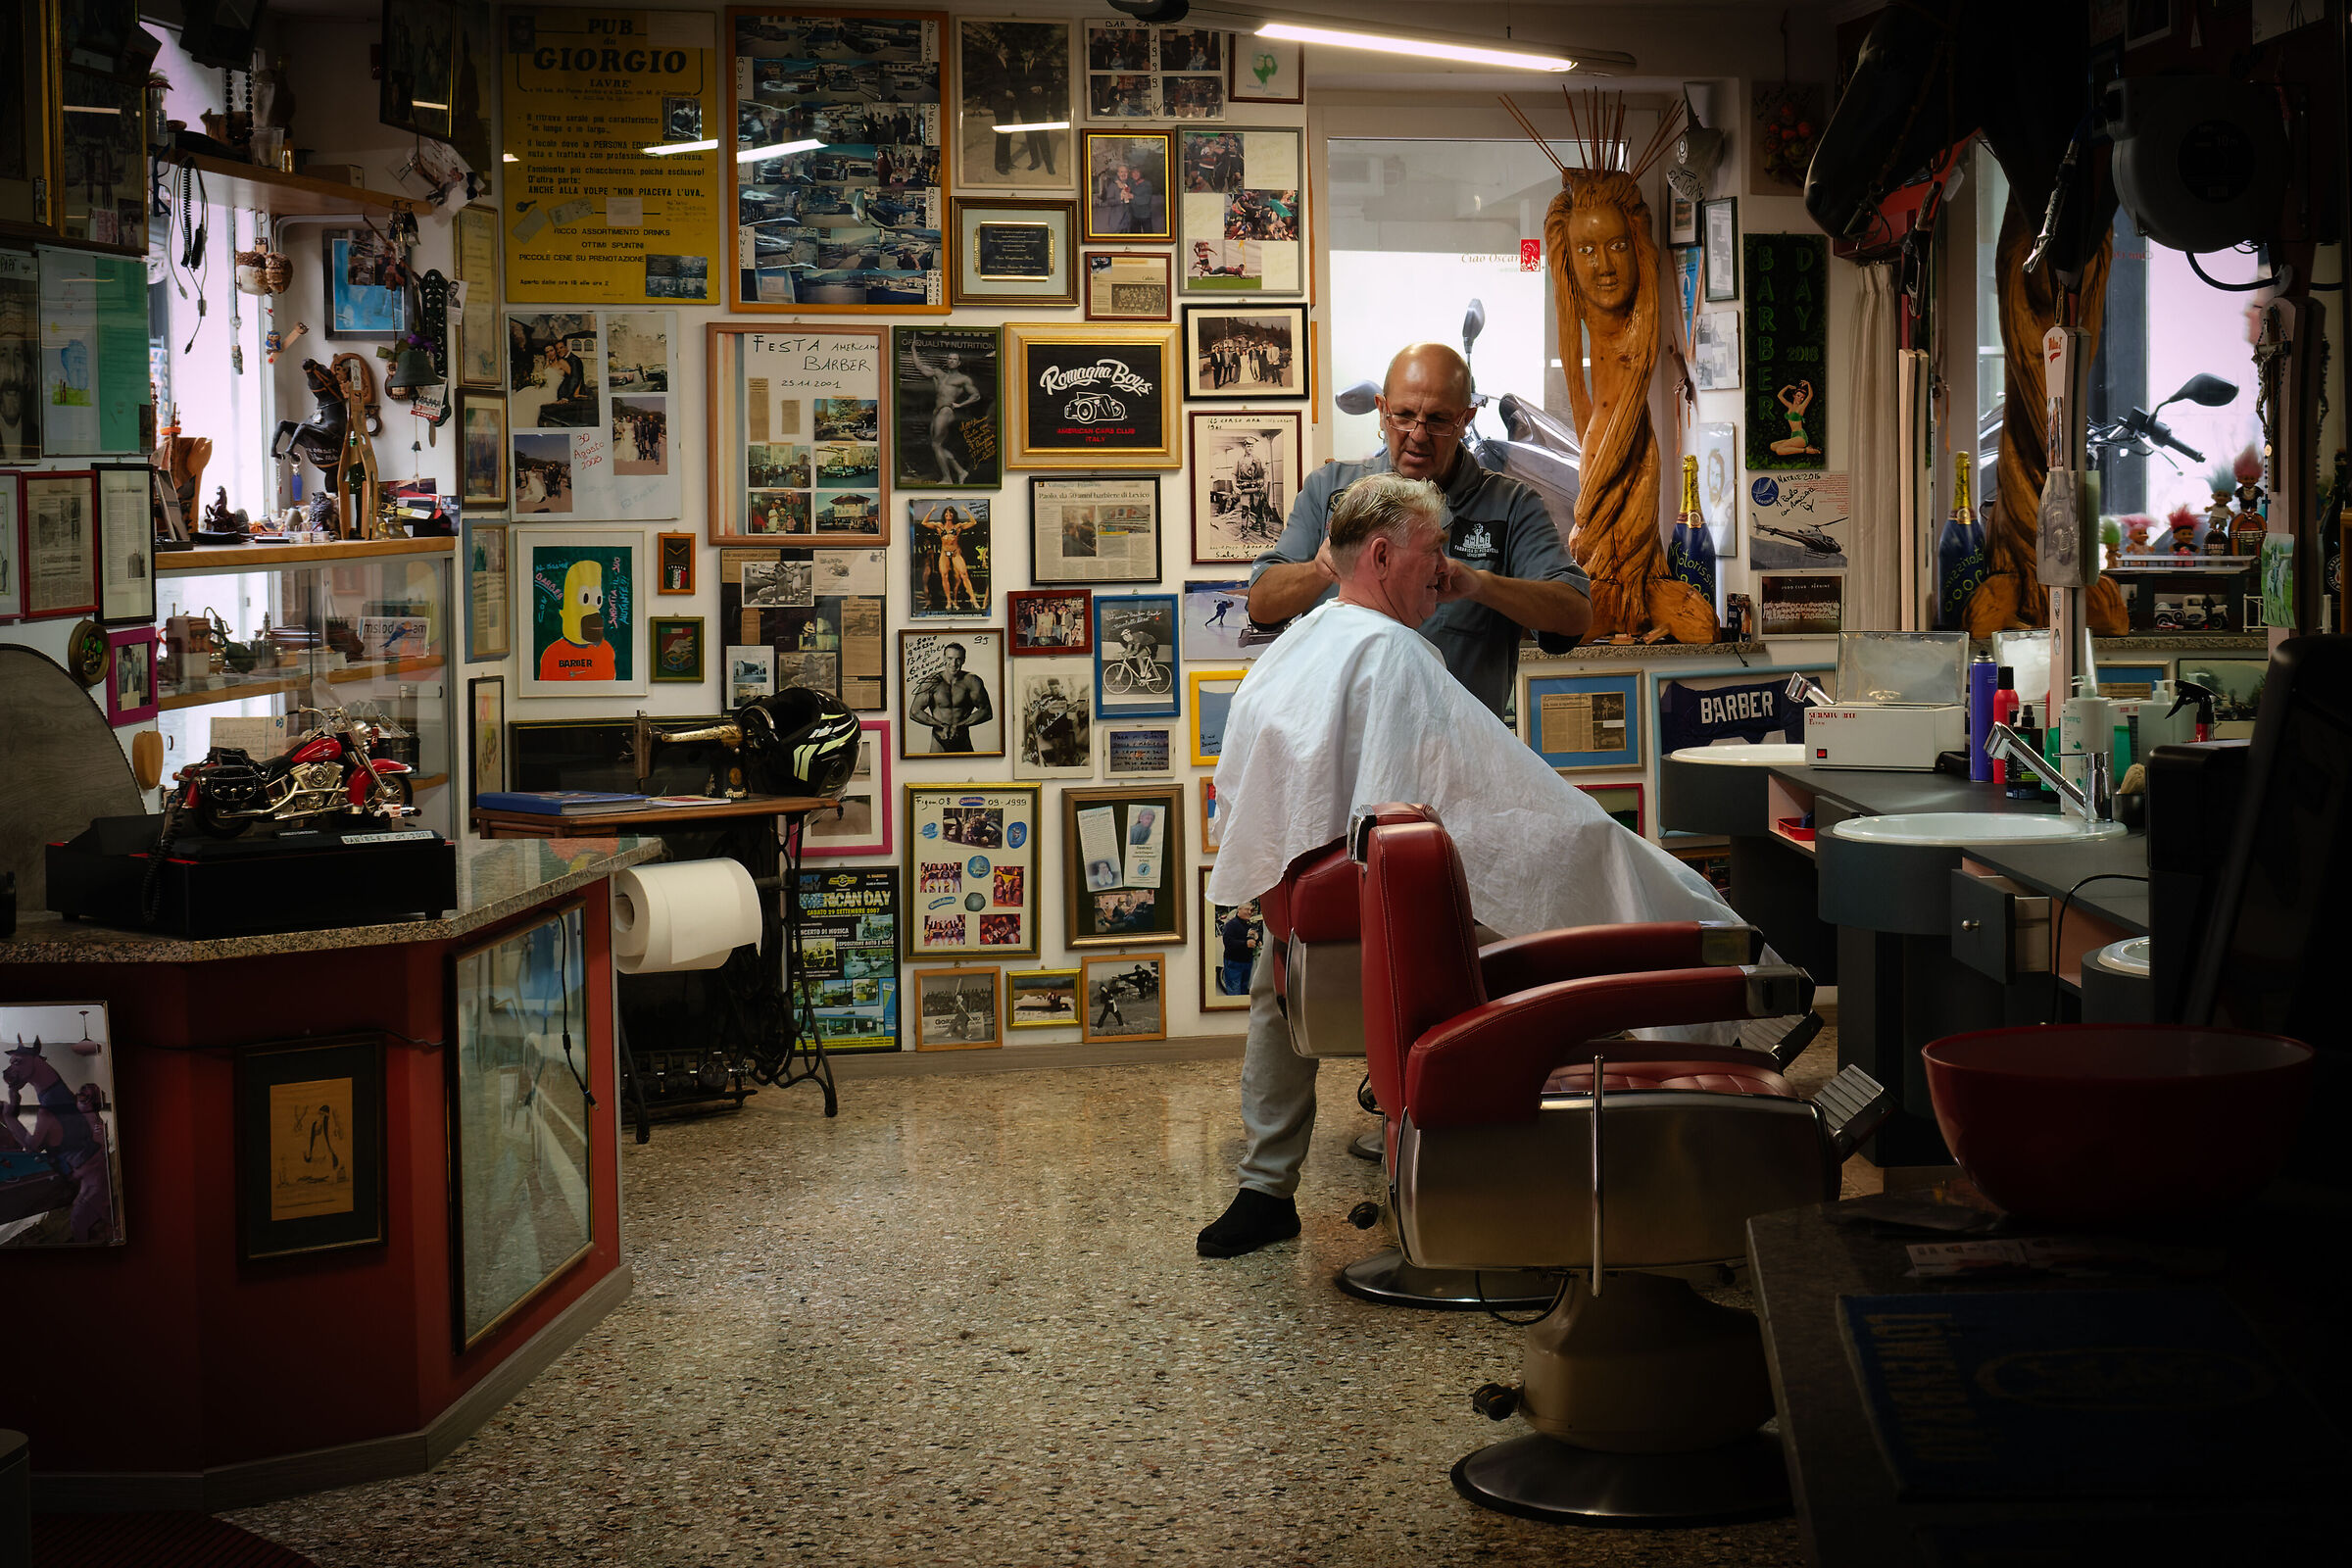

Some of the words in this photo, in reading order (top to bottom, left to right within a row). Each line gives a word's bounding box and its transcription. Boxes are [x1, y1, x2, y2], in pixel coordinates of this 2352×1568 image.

[588, 19, 633, 35] PUB
[534, 47, 687, 74] GIORGIO
[639, 187, 671, 196] PIACEVA
[1461, 254, 1486, 263] Ciao
[1489, 253, 1521, 263] Oscar
[1794, 245, 1815, 332] DAY
[1756, 245, 1778, 421] BARBER
[754, 334, 819, 353] FESTA
[915, 339, 950, 349] QUALITY
[953, 341, 995, 350] NUTRITION
[803, 356, 871, 371] BARBER
[1040, 365, 1113, 396] Romagna
[1096, 359, 1153, 398] Boys
[576, 432, 591, 447] 30
[572, 439, 606, 461] Agosto
[559, 659, 593, 667] BARBER
[1700, 690, 1775, 724] BARBER
[862, 890, 892, 906] DAY
